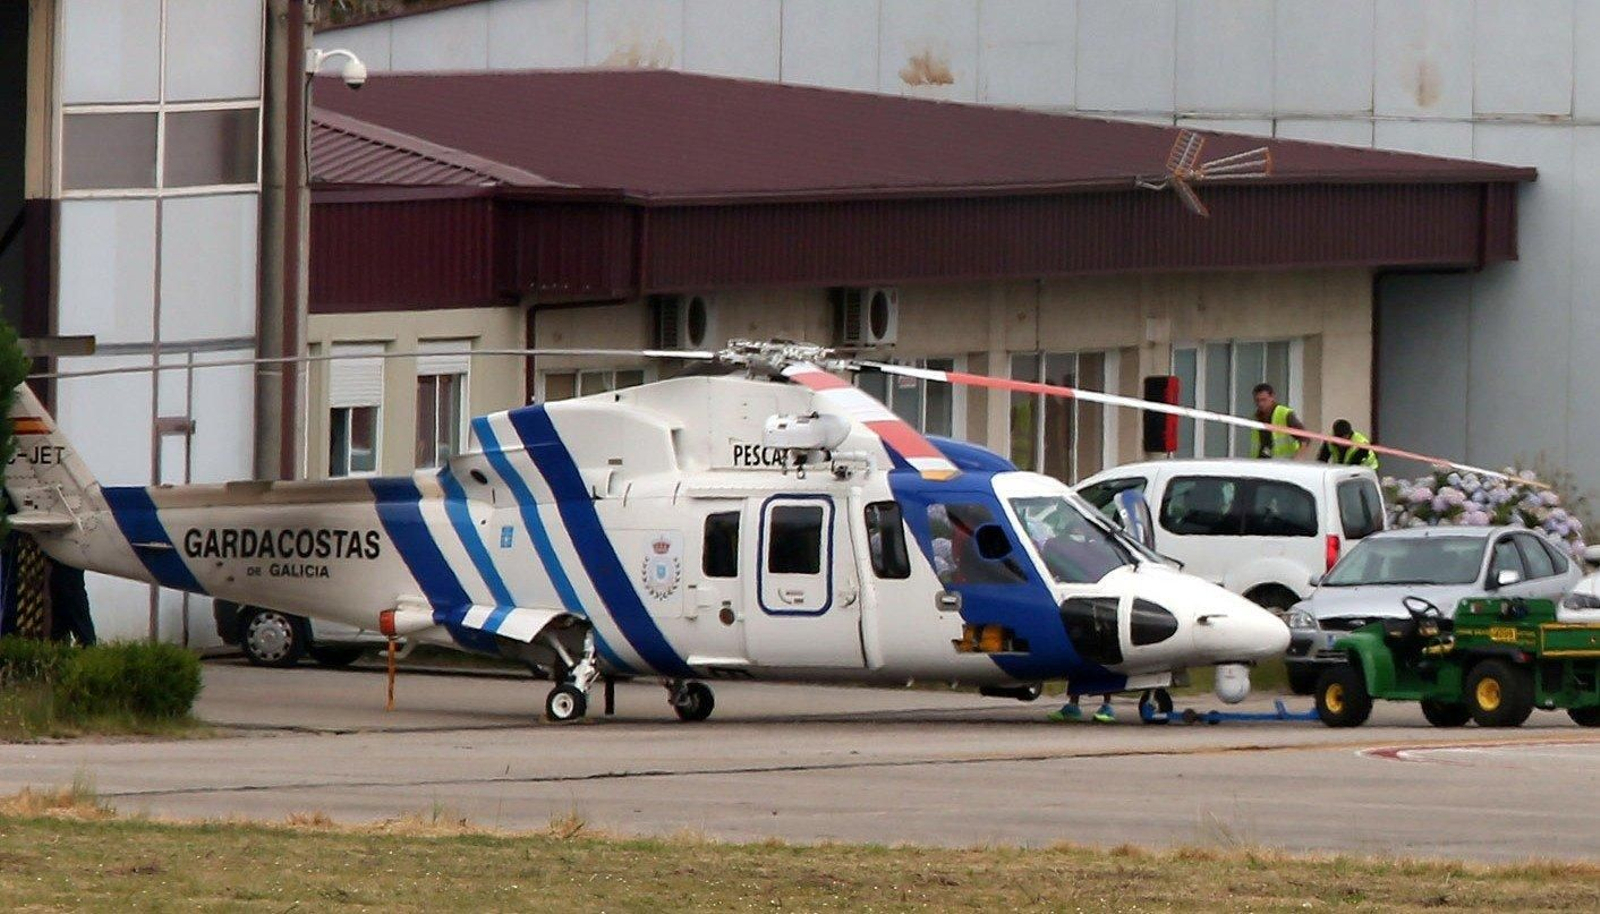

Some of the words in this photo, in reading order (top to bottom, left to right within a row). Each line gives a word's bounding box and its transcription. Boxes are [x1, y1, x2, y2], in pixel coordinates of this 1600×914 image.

[184, 527, 381, 560] GARDACOSTAS
[247, 565, 262, 577] DE
[269, 563, 330, 578] GALICIA
